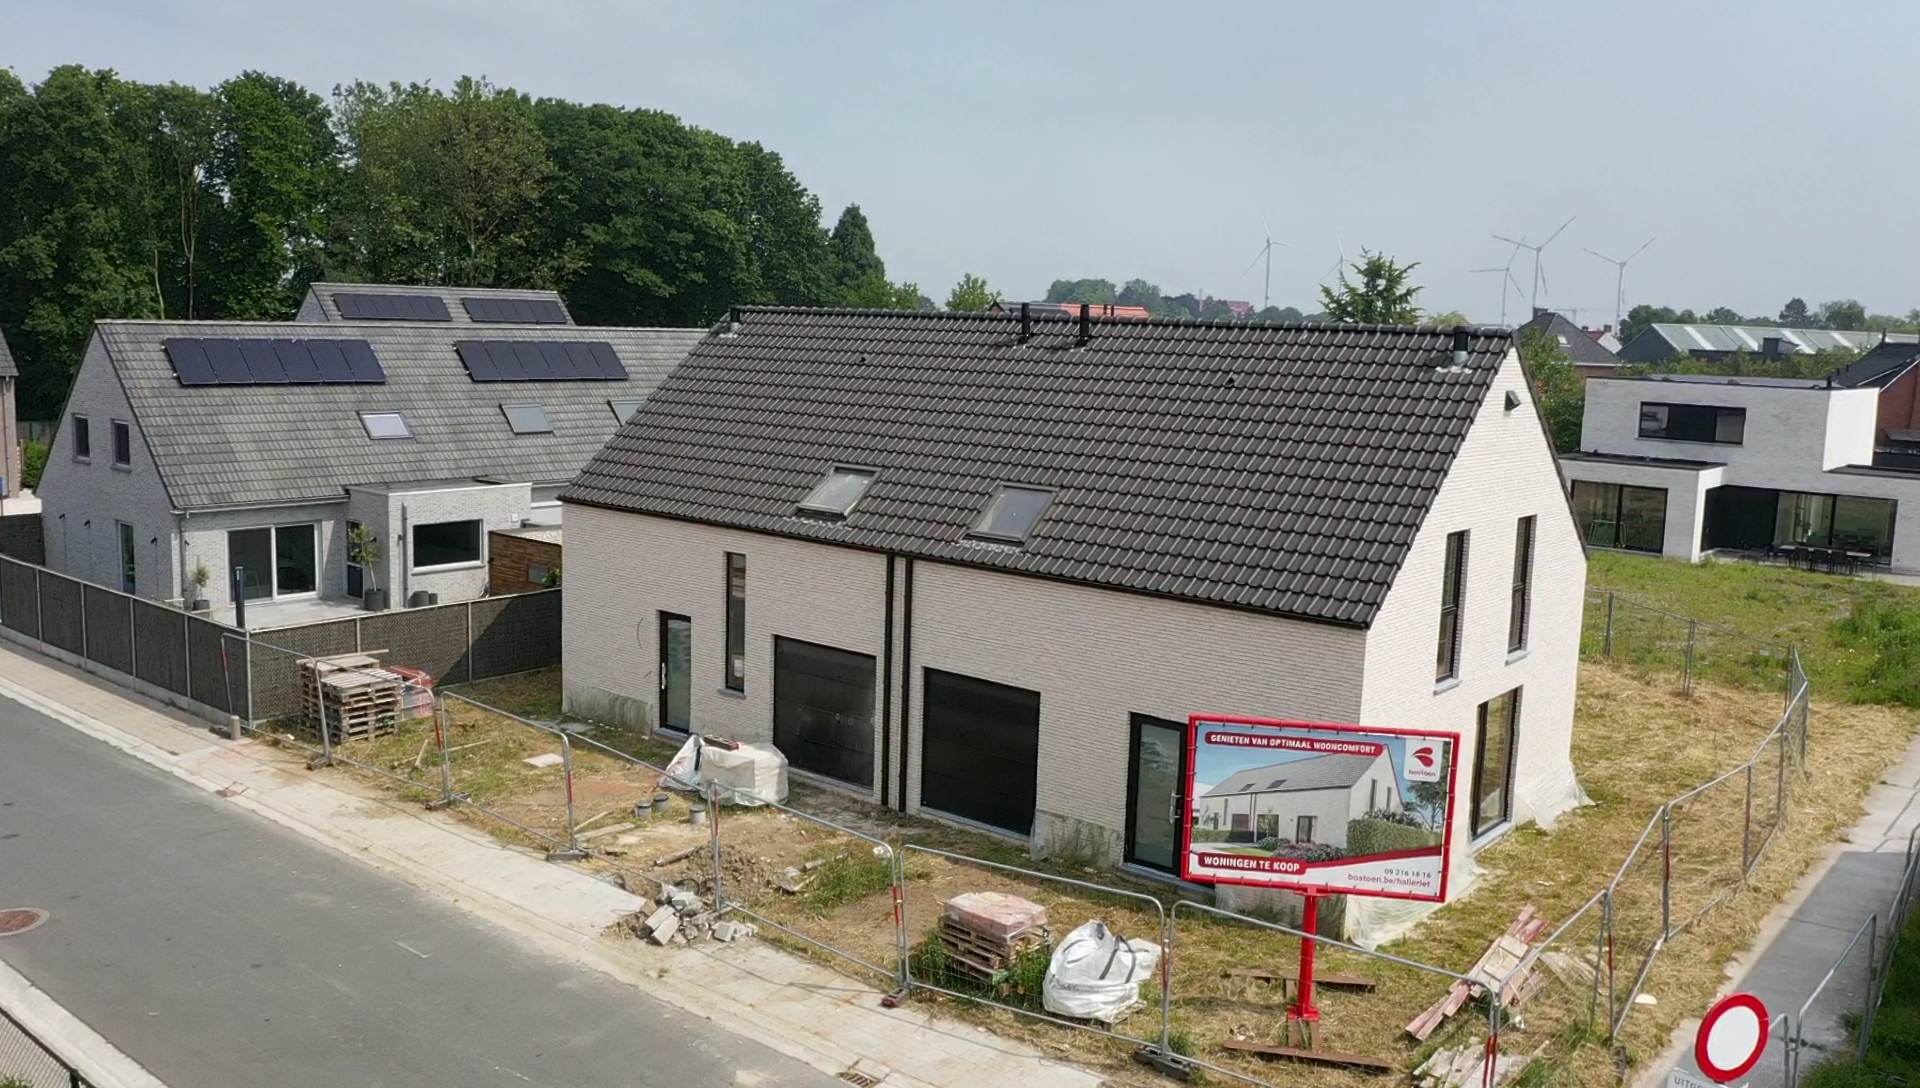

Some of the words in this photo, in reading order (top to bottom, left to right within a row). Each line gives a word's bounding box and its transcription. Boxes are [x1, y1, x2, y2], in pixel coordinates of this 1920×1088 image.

[1210, 734, 1250, 745] GENIETEN
[1251, 738, 1268, 746] VAN
[1269, 738, 1312, 749] OPTIMAAL
[1313, 742, 1376, 754] WOONCOMFORT
[1203, 856, 1257, 869] WONINGEN
[1259, 860, 1271, 870] TE
[1272, 862, 1300, 872] KOOP
[1395, 869, 1410, 877] 216
[1422, 871, 1432, 879] 16
